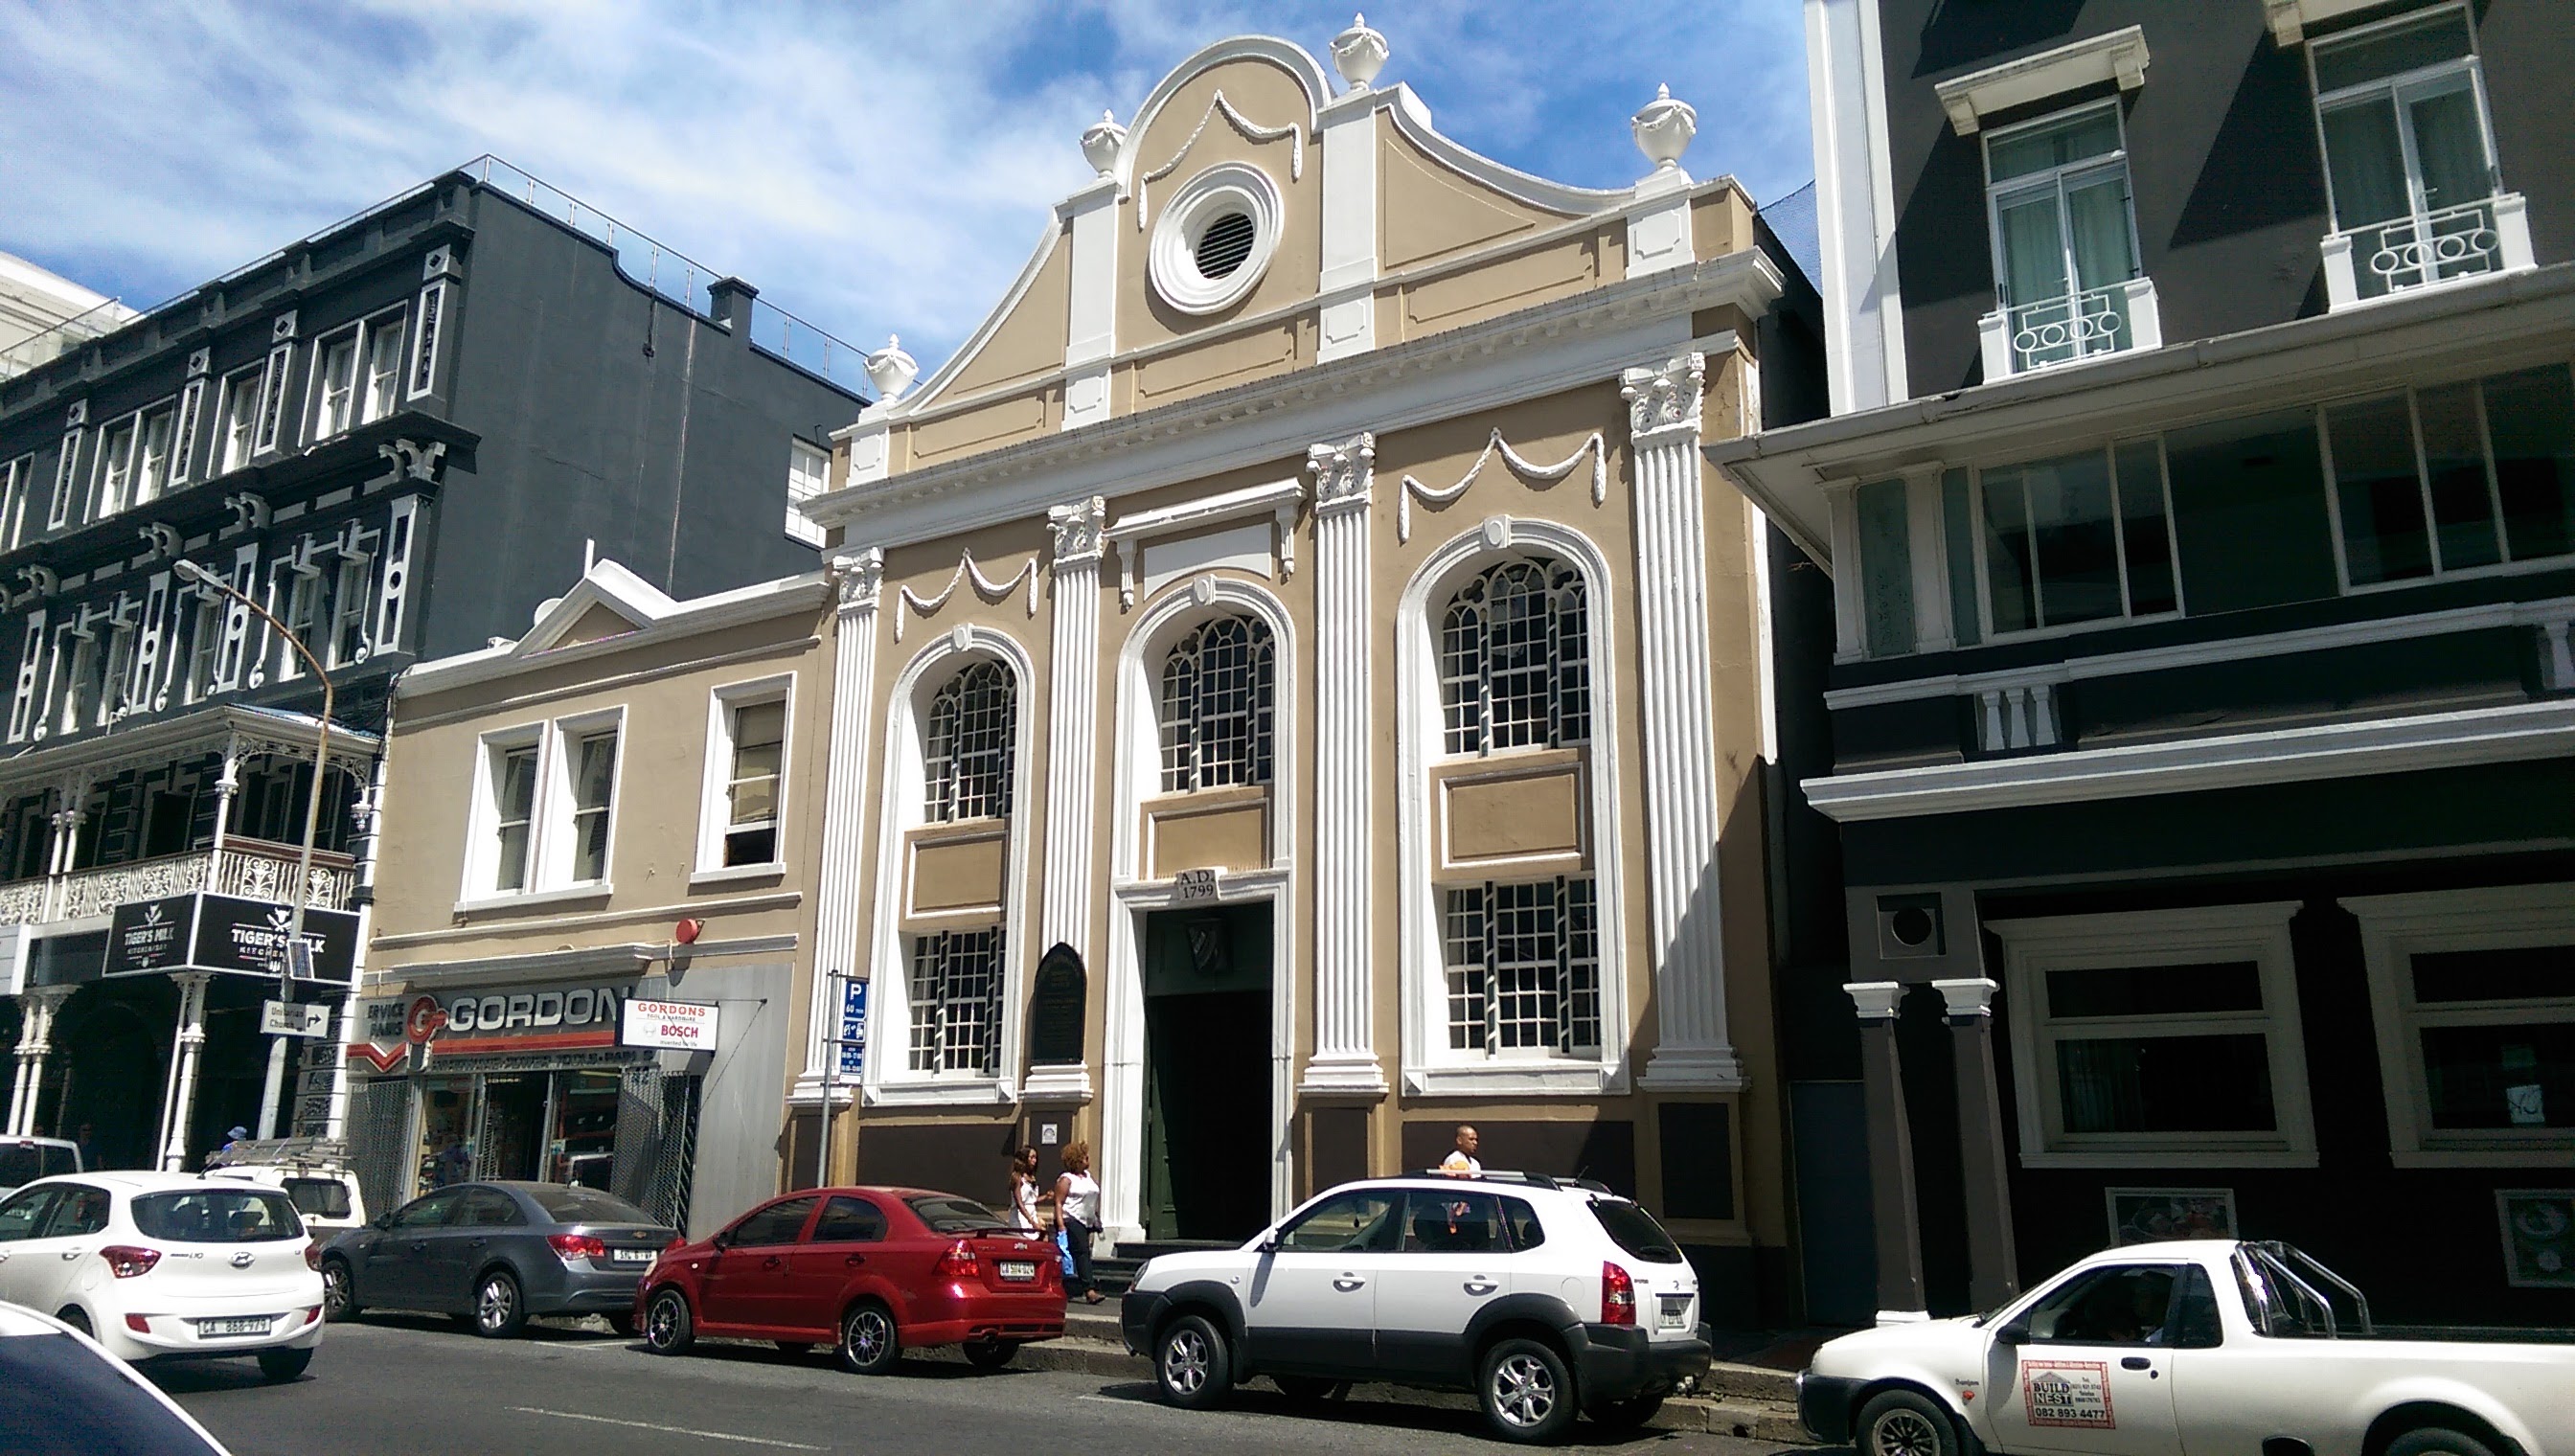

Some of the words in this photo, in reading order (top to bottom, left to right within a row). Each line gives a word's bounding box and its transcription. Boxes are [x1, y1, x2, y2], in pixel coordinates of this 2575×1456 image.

[1184, 884, 1214, 899] 1799
[125, 930, 153, 946] TIGER'S
[231, 929, 286, 948] TIGER'S
[851, 984, 861, 1000] P
[638, 1003, 706, 1017] GORDONS
[661, 1025, 698, 1038] BOSCH
[2033, 1382, 2069, 1393] BUILD
[2034, 1394, 2072, 1405] NEST
[2035, 1407, 2055, 1418] 082
[2058, 1408, 2077, 1418] 893
[2080, 1409, 2105, 1419] 4477
